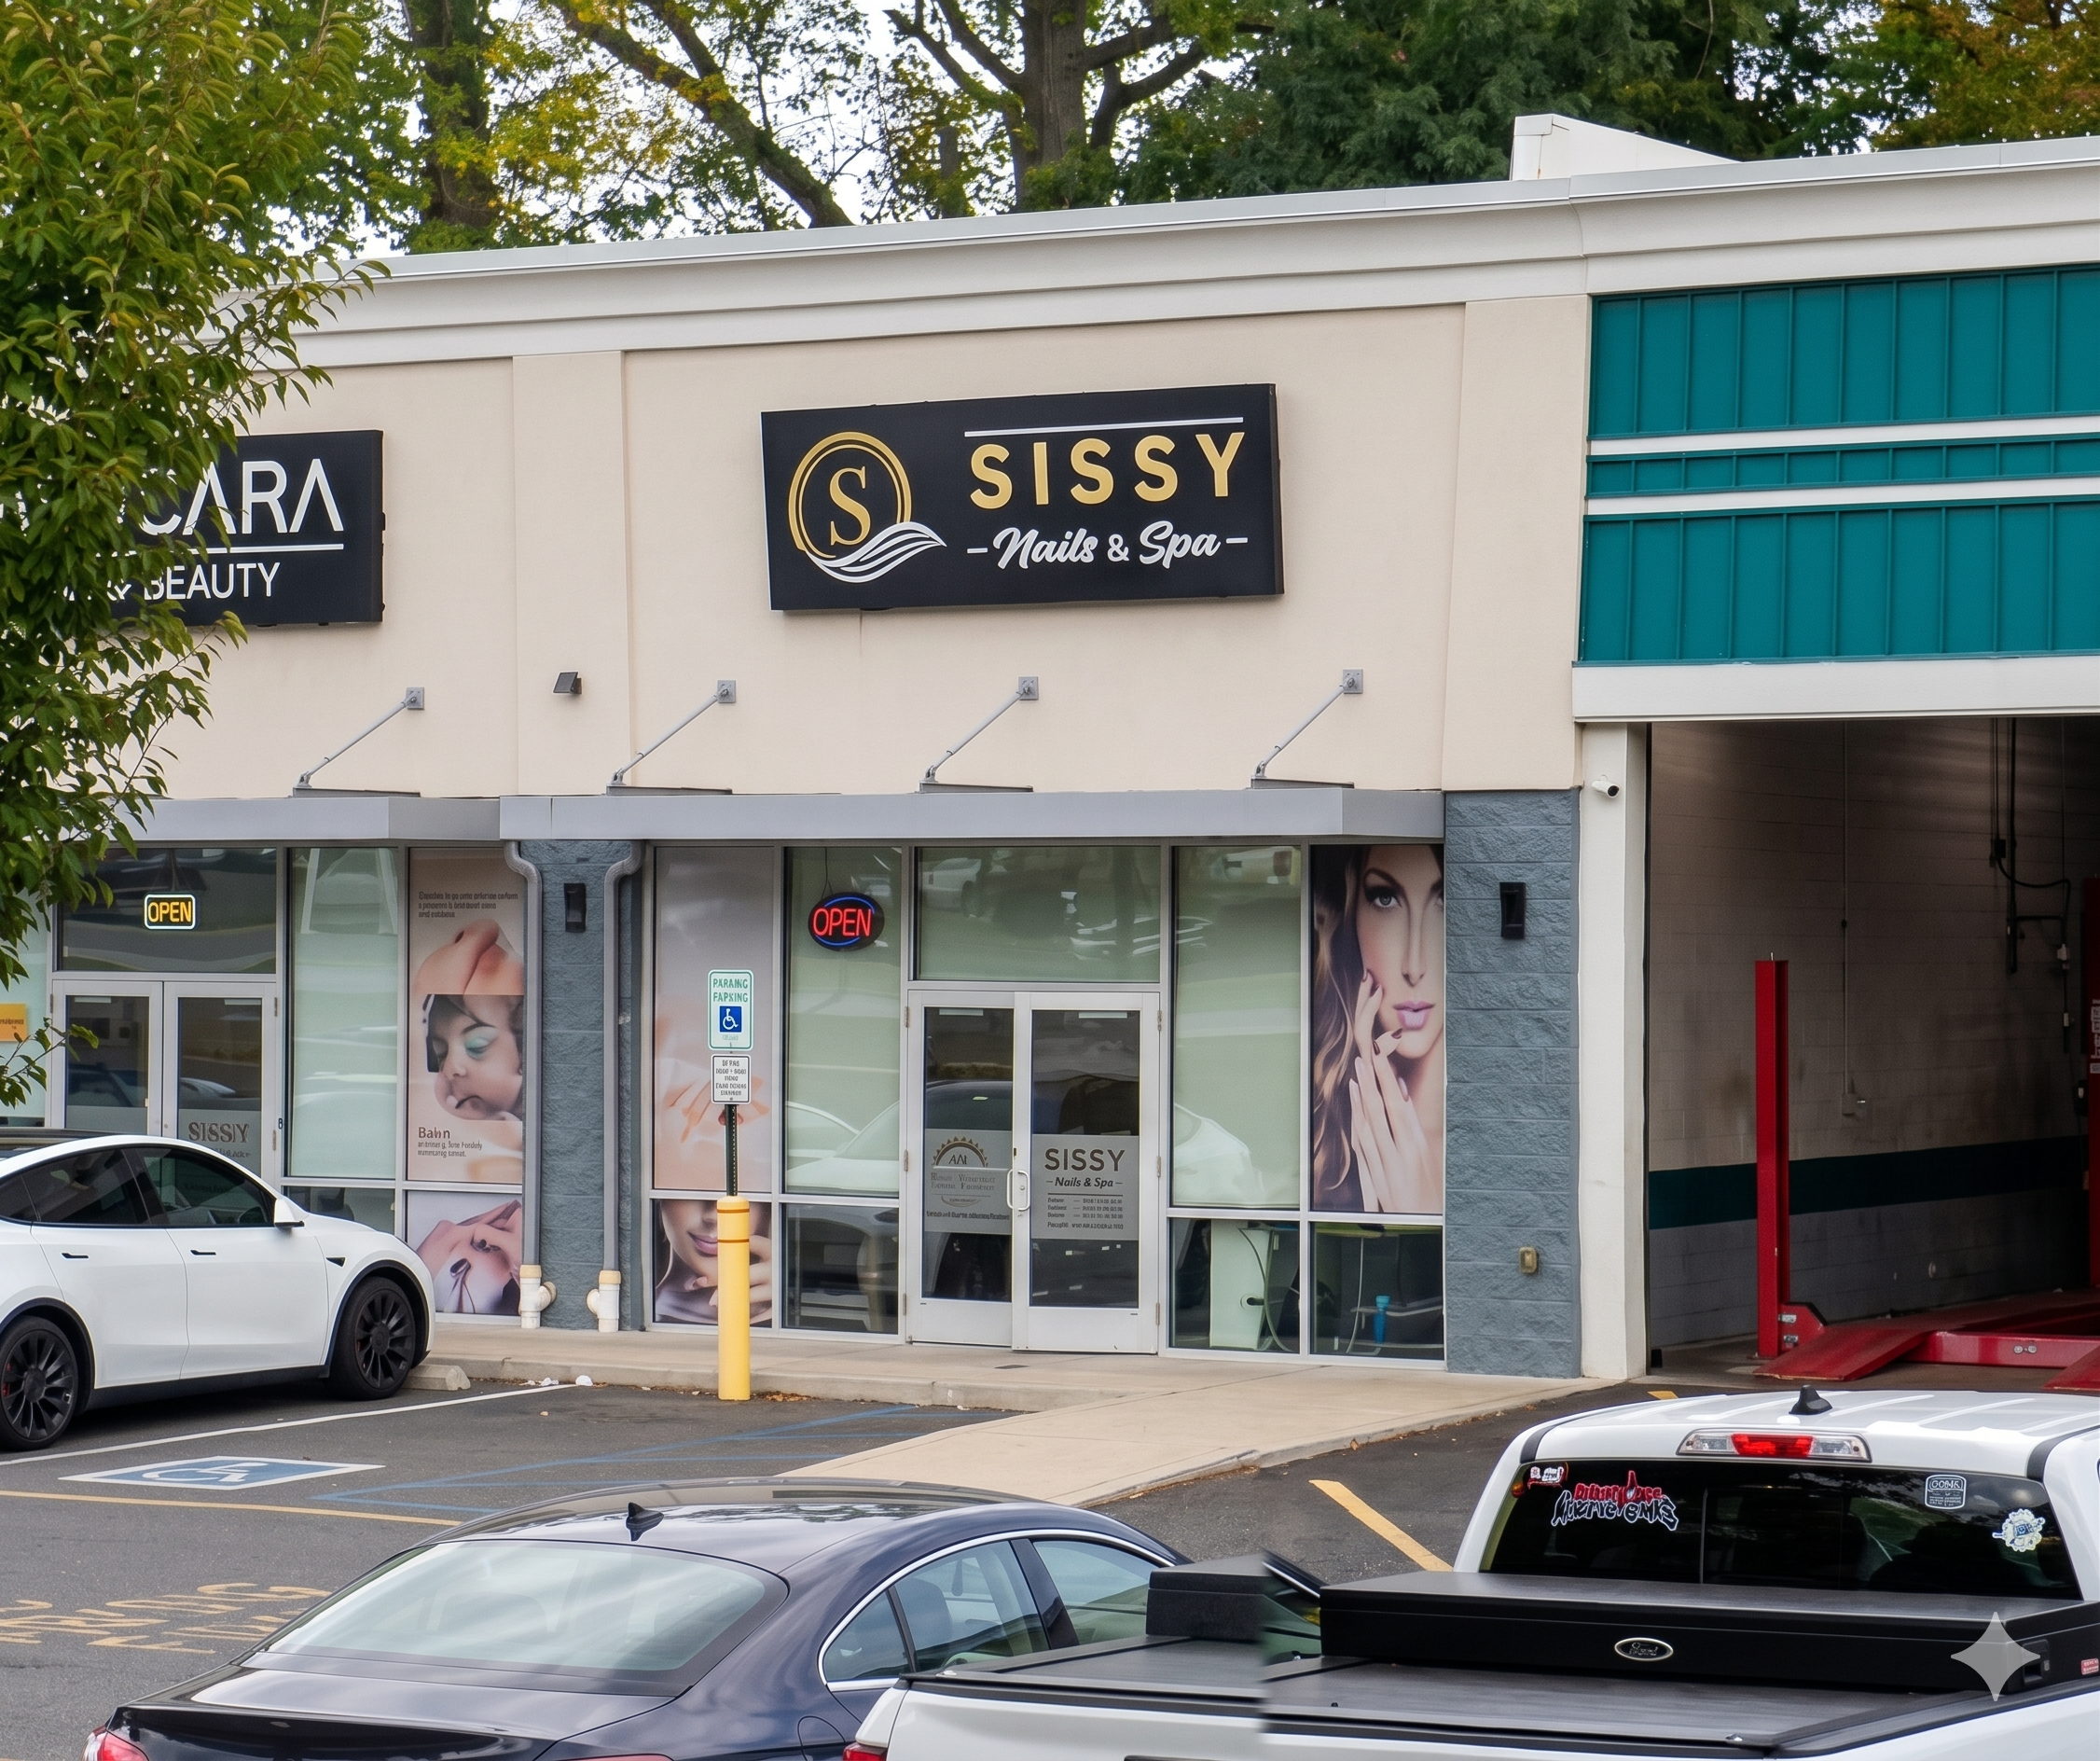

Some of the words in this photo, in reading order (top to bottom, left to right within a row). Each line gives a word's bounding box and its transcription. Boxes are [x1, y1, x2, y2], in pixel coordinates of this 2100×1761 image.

[970, 433, 1244, 509] SISSY
[829, 465, 871, 547] S
[992, 526, 1098, 570] Nails
[1107, 534, 1130, 562] &
[1139, 520, 1222, 569] Spa
[145, 562, 281, 600] BEAUTY
[148, 901, 192, 922] OPEN
[813, 908, 872, 936] OPEN
[1044, 1148, 1125, 1172] SISSY
[1055, 1177, 1082, 1187] Nails
[1084, 1177, 1092, 1187] &
[1094, 1177, 1113, 1189] Spa
